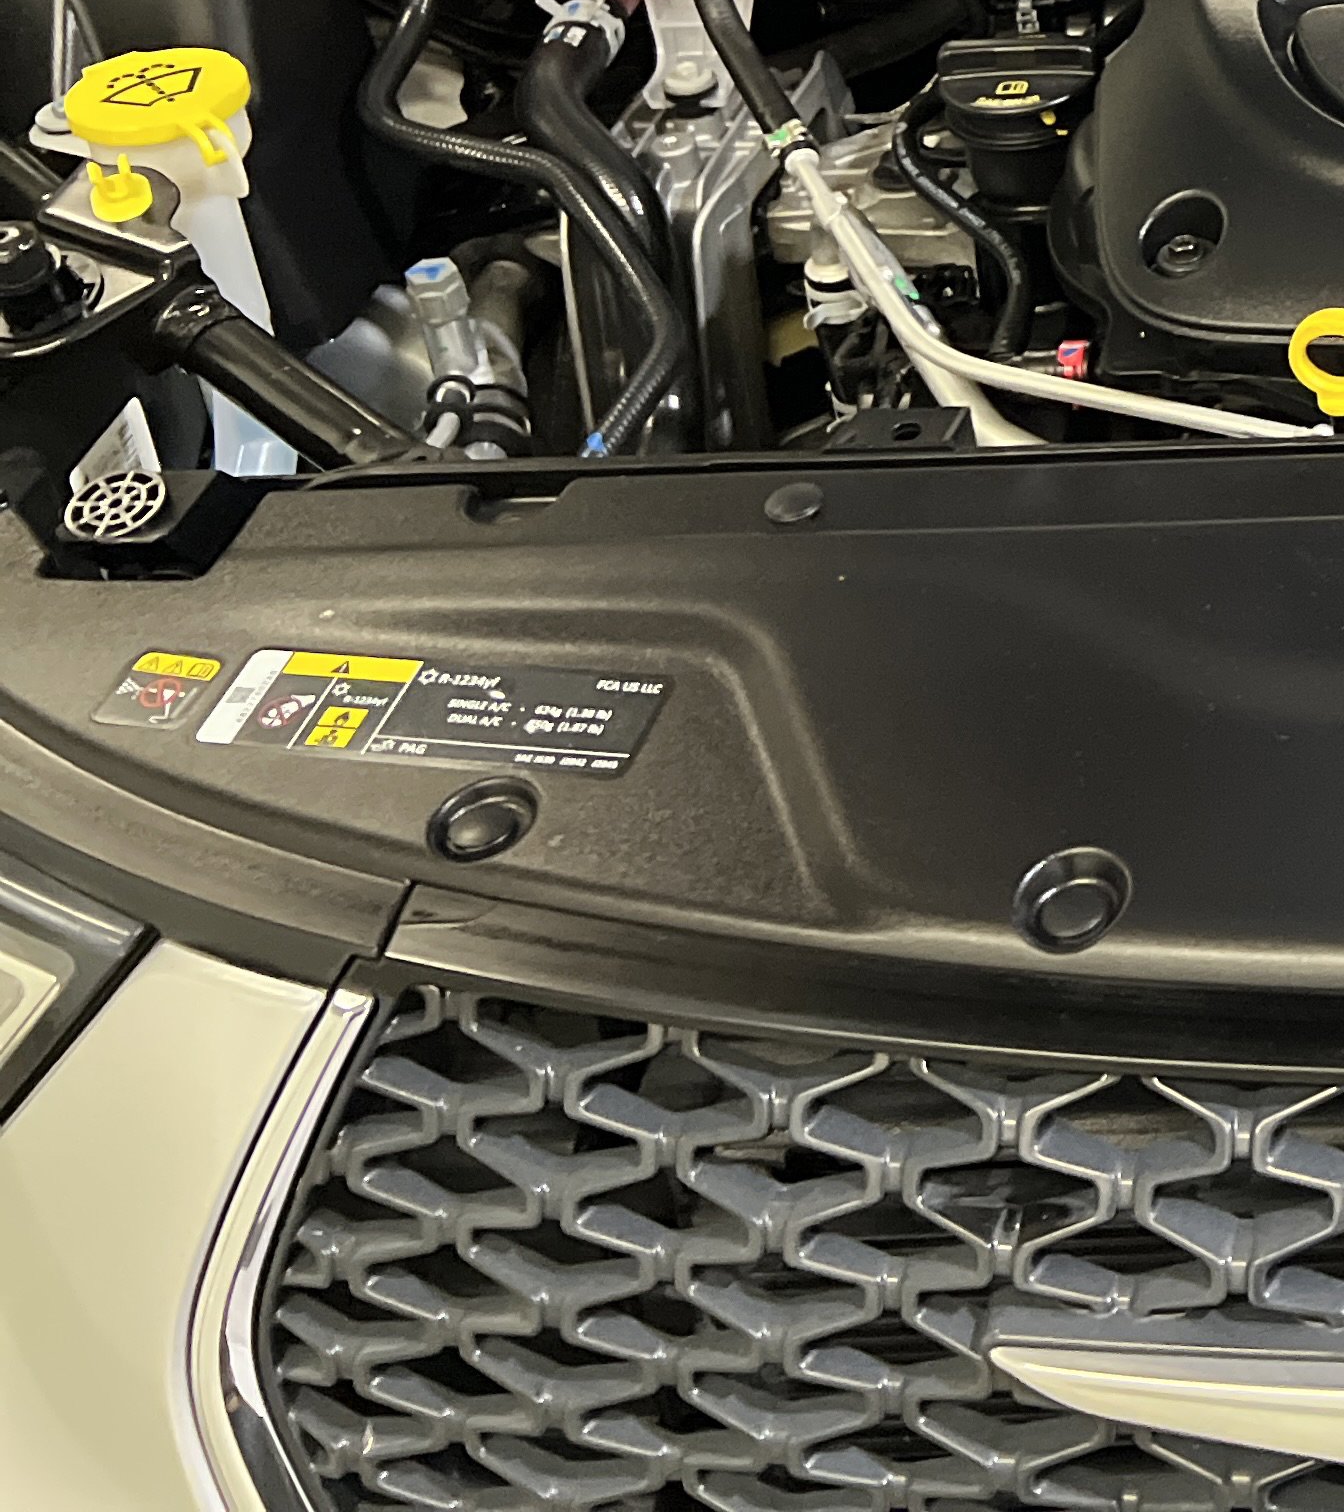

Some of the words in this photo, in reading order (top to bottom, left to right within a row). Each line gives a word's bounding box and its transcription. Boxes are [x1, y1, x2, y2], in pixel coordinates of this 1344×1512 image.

[438, 673, 501, 689] R-1234yf
[596, 679, 621, 692] FCA
[623, 681, 641, 693] US
[641, 683, 664, 695] LLC
[447, 713, 478, 725] DUAL
[479, 716, 503, 727] A/C
[398, 742, 428, 755] PAG
